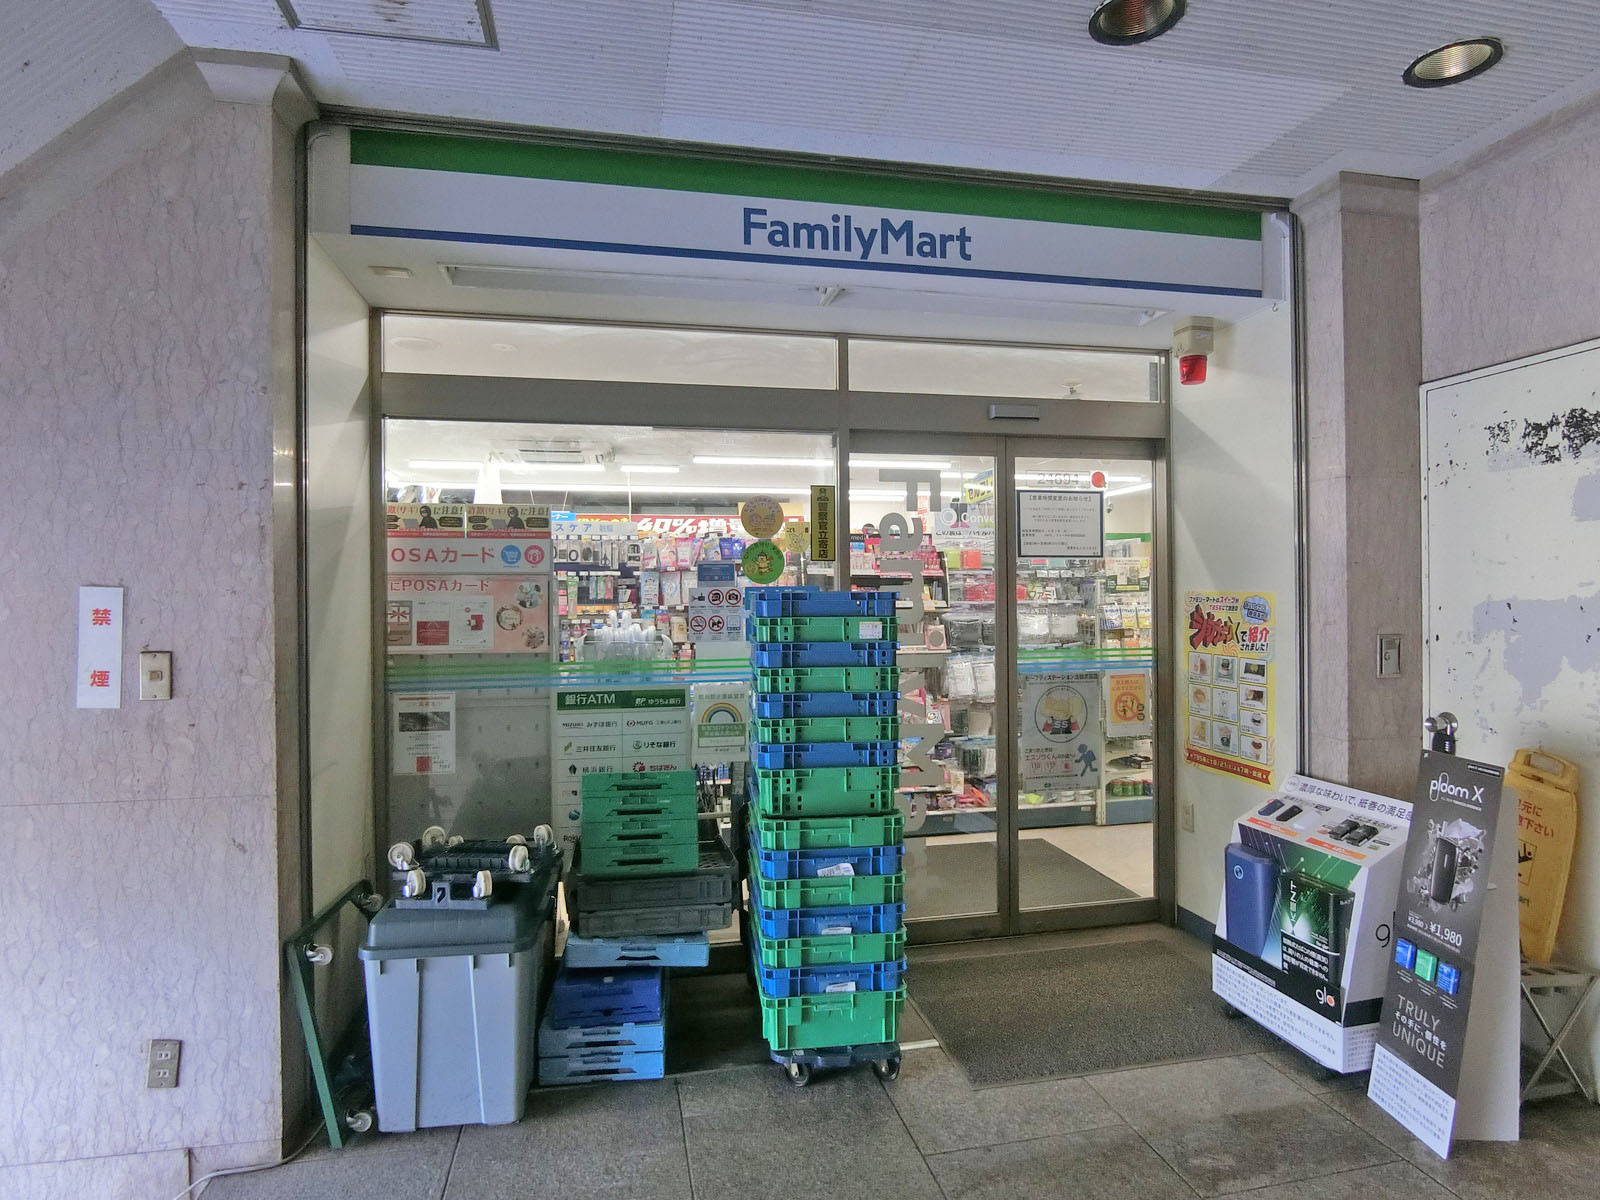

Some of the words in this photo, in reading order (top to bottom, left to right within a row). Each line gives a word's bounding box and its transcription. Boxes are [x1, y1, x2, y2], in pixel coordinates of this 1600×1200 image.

[743, 207, 972, 261] FamilyMart
[817, 502, 829, 559] 警察官立寄店
[391, 547, 495, 563] OSAカード
[390, 580, 489, 592] にPOSAカード
[1240, 626, 1271, 643] で紹介
[90, 608, 112, 688] 禁煙
[1240, 642, 1269, 652] されました!
[564, 693, 616, 705] 銀行ATM
[647, 697, 682, 705] ゆうちょ銀行
[586, 720, 618, 728] みずほ銀行
[575, 744, 617, 753] 三井住友銀行
[643, 740, 677, 749] りそな銀行
[582, 765, 613, 773] 横浜銀行
[1429, 772, 1469, 802] ploom
[1471, 785, 1485, 804] X
[1429, 921, 1463, 947] ¥1,980
[1315, 986, 1336, 1008] glo
[1397, 994, 1441, 1032] TRULY
[1392, 1021, 1446, 1069] UNIQUE
